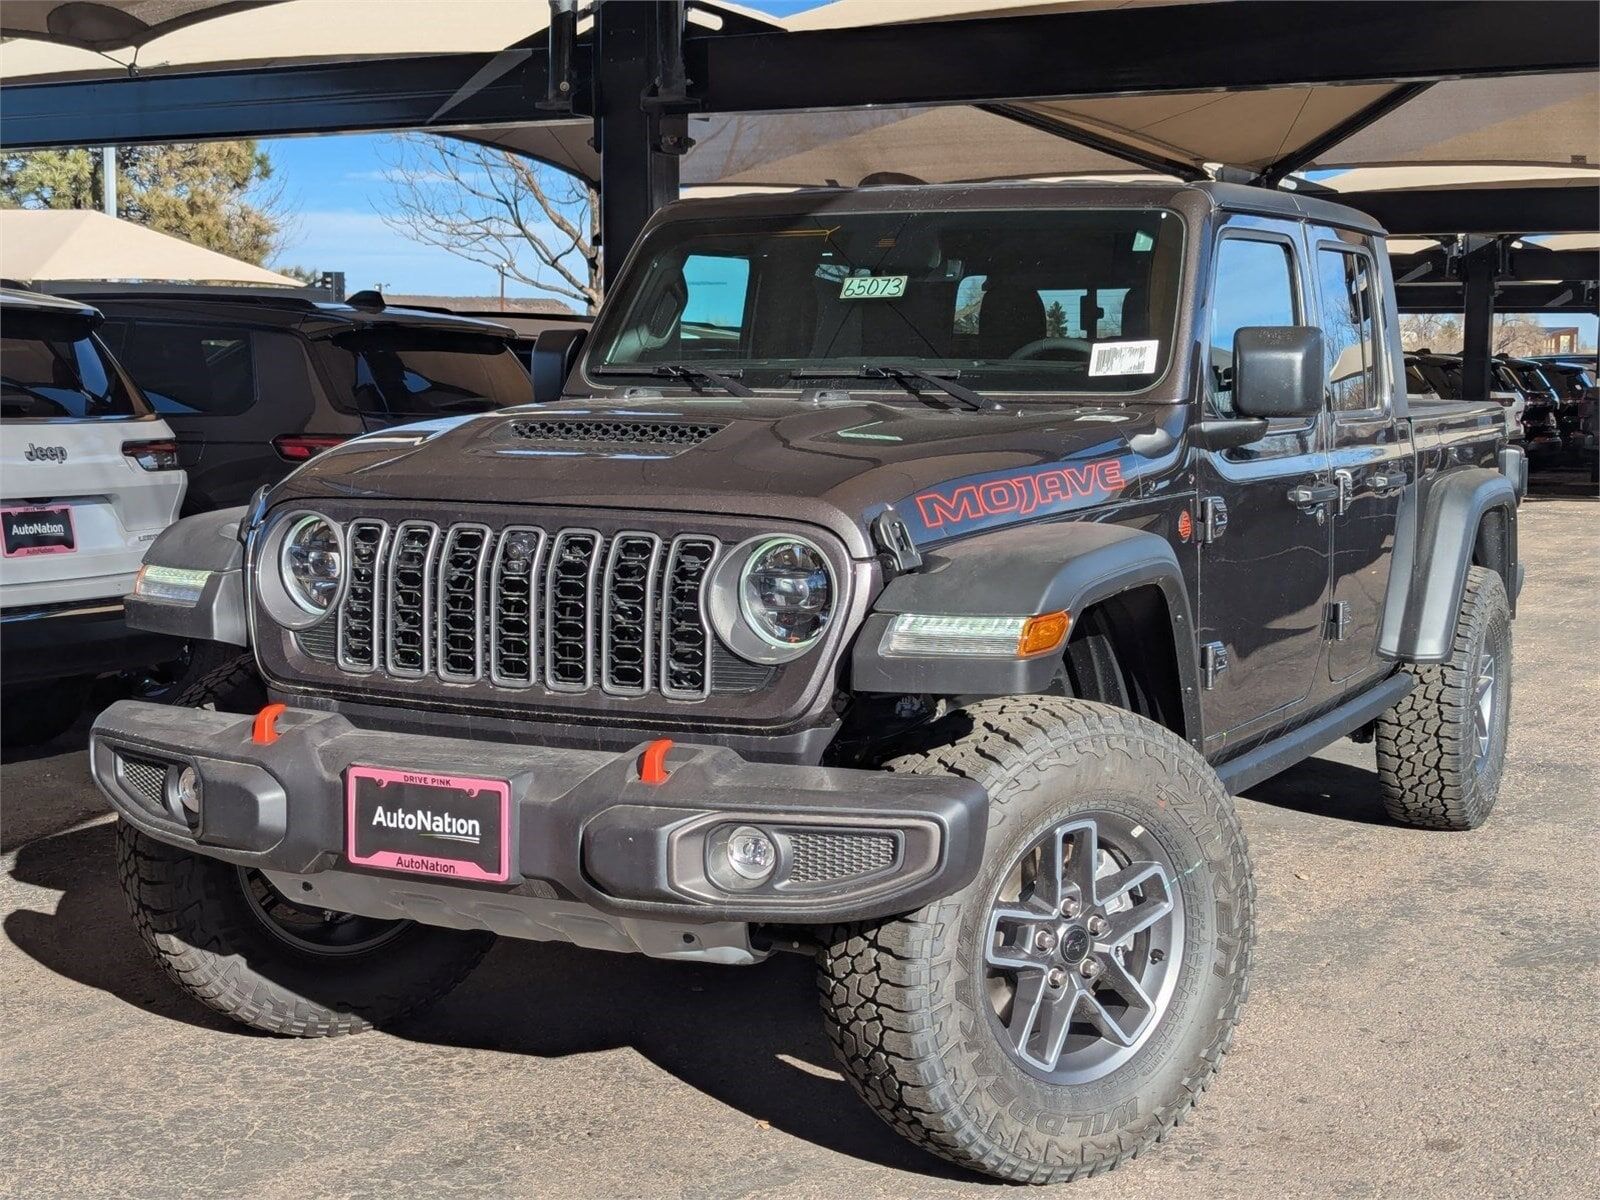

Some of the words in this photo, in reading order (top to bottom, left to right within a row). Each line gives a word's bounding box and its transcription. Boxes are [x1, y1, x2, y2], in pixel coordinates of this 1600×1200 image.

[843, 277, 903, 297] 65073
[24, 443, 68, 464] Jeep
[915, 459, 1126, 529] MOJAVE
[11, 523, 64, 536] AutoNation
[403, 774, 429, 785] DRIVE
[431, 778, 452, 787] PINK
[372, 805, 482, 836] AutoNation
[395, 856, 457, 875] AutoNation
